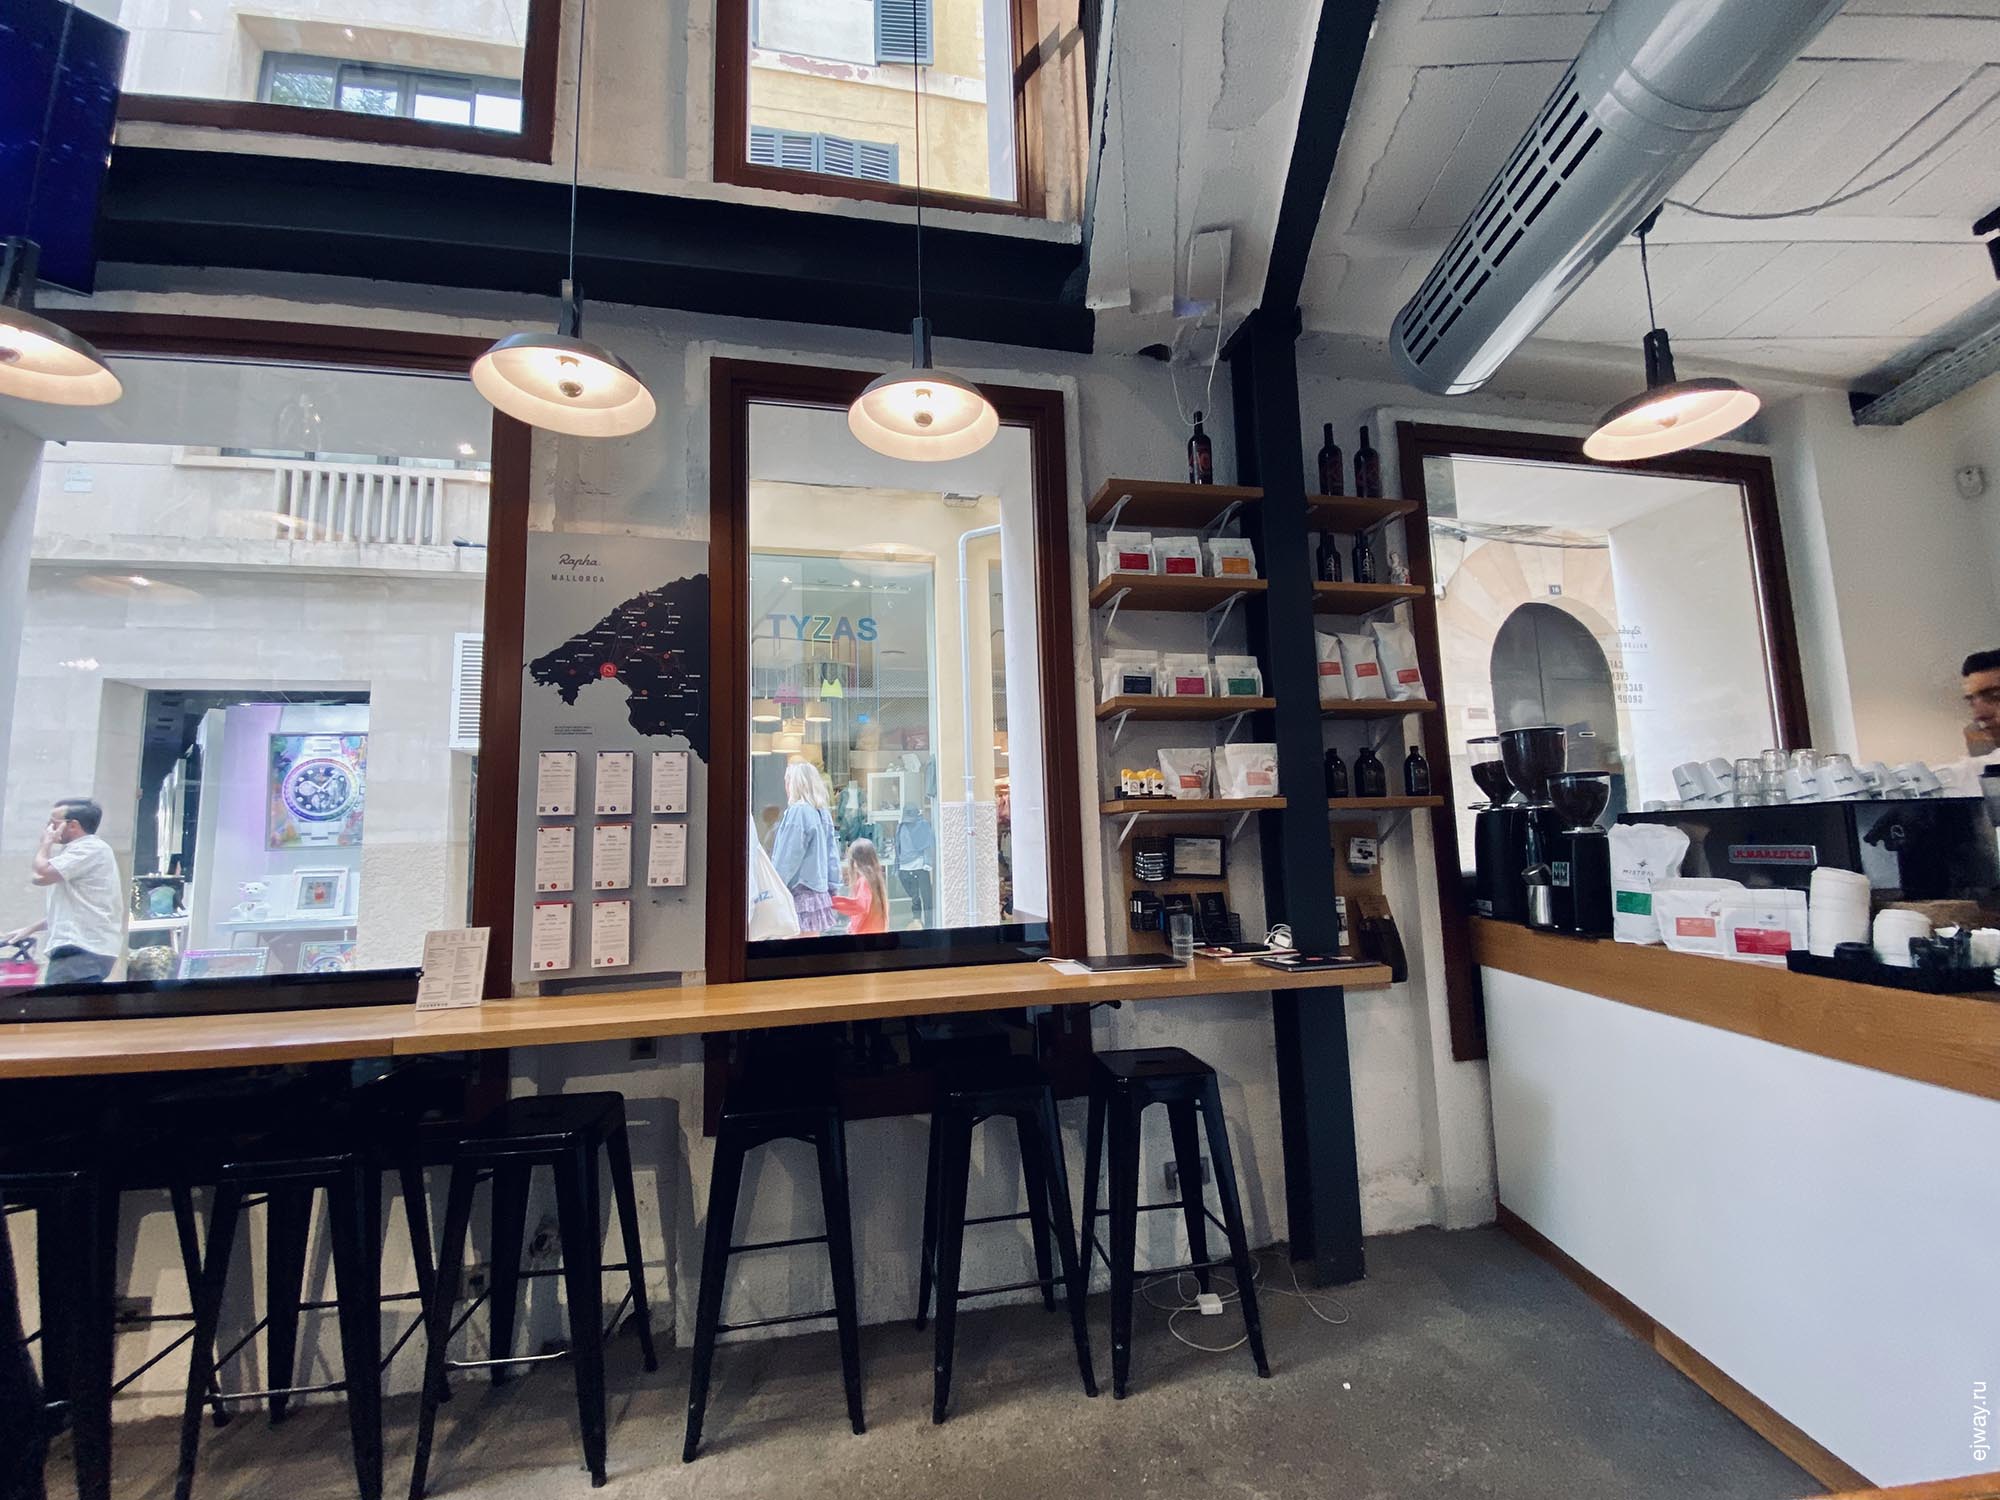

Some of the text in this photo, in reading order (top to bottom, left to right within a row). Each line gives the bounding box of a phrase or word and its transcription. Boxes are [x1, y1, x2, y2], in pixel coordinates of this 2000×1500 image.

[559, 553, 598, 570] Rapha
[551, 574, 605, 583] MALLORCA
[767, 614, 878, 642] TYZAS
